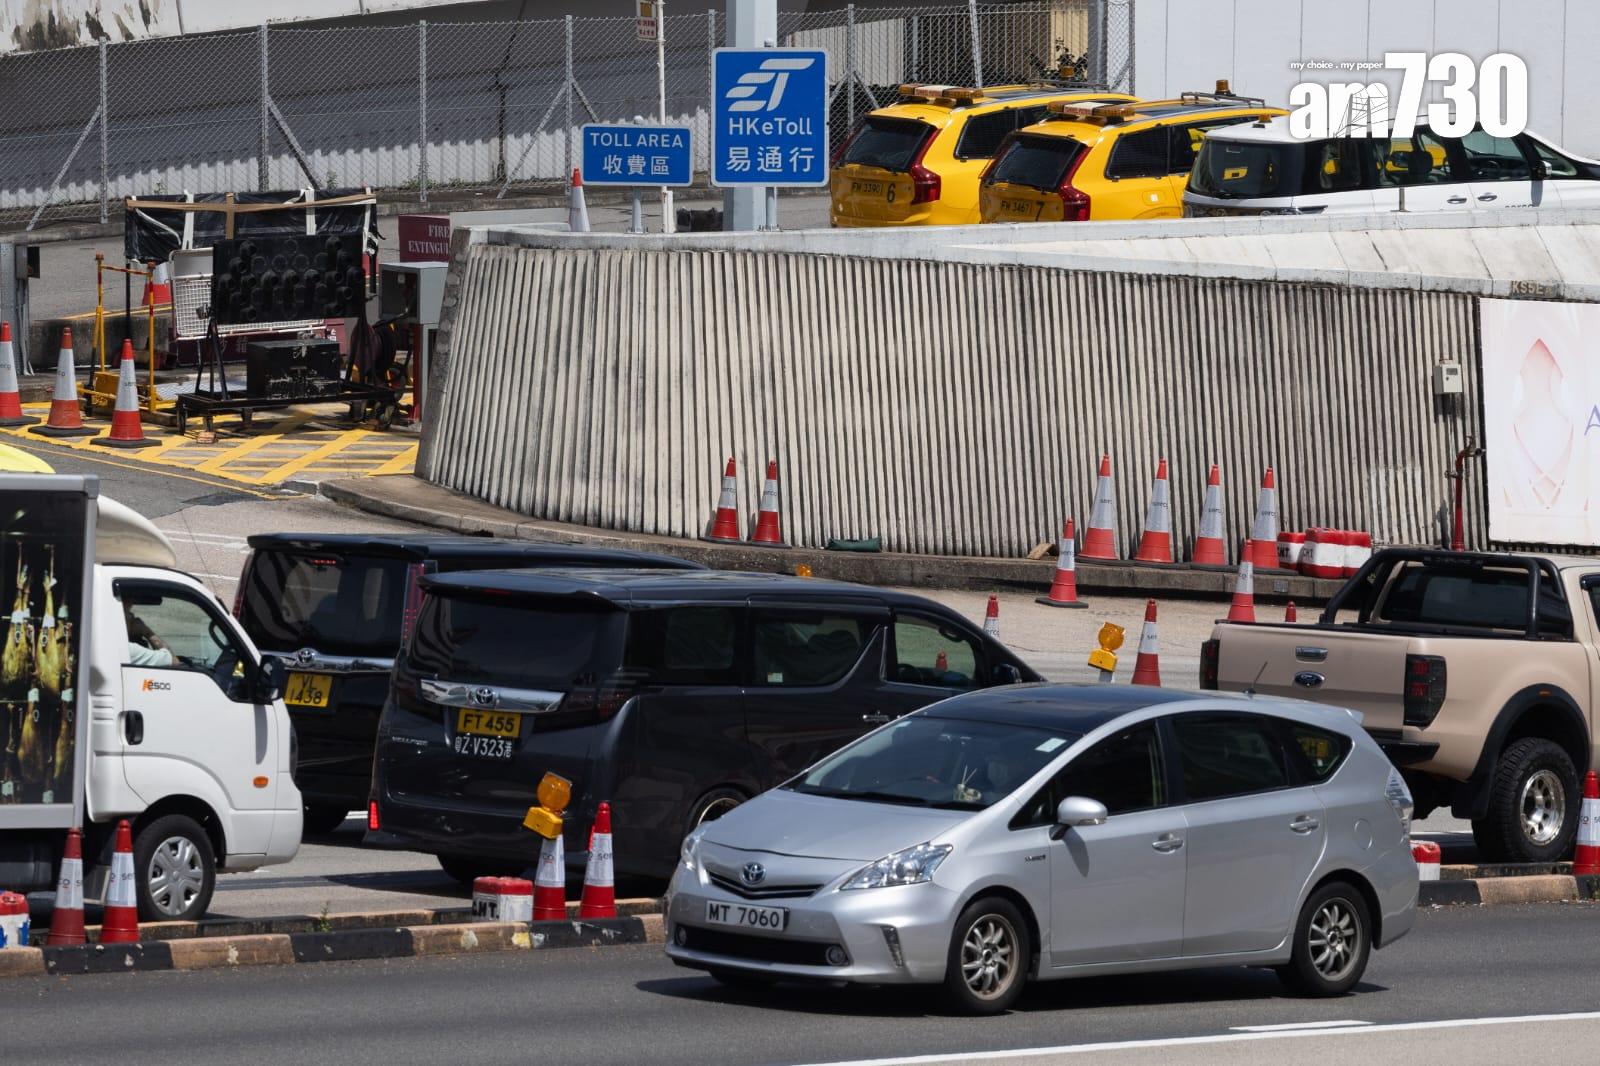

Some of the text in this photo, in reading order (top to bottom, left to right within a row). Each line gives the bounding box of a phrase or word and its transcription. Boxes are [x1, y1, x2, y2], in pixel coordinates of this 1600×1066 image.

[728, 117, 812, 135] HKeToll
[590, 132, 683, 148] TOLL AREA
[603, 154, 670, 175] 收費區
[726, 146, 815, 172] 易通行
[887, 183, 896, 203] 6
[1035, 200, 1046, 221] 7
[408, 240, 449, 254] EXTINGUI
[290, 688, 322, 705] 1438
[463, 713, 515, 733] FT 455
[709, 903, 780, 928] MT 7060
